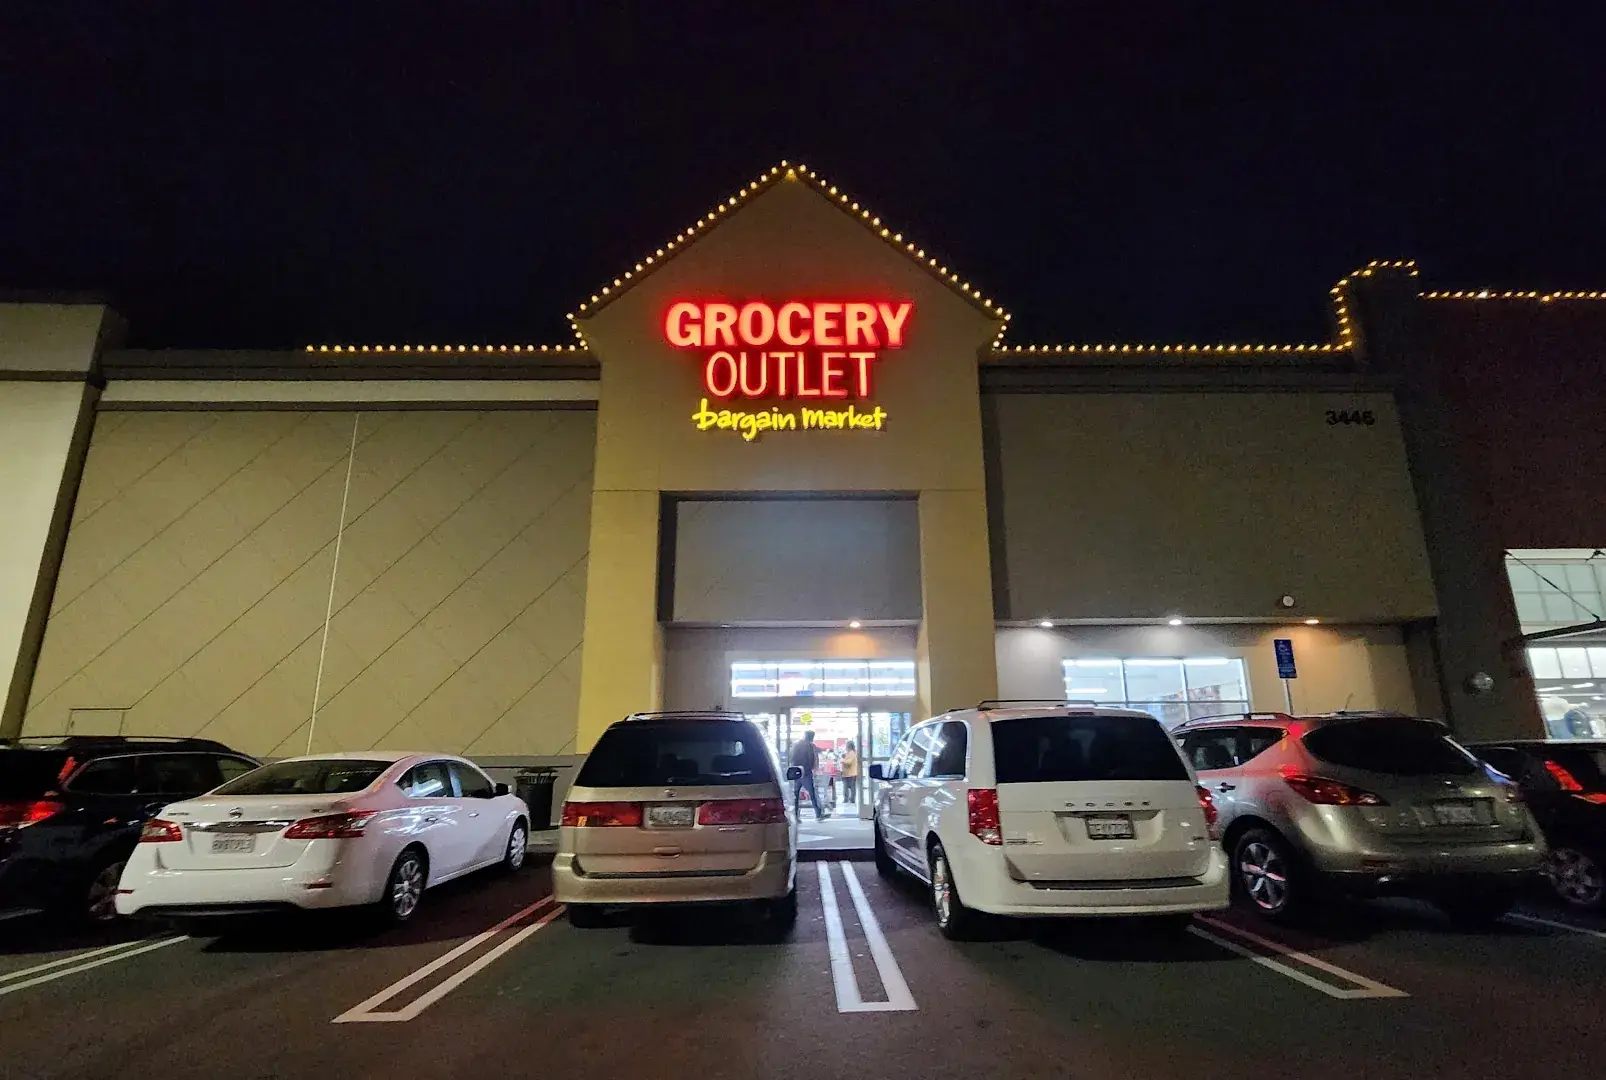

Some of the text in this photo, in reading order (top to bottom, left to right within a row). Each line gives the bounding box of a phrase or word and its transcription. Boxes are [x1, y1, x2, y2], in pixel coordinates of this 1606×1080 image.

[664, 301, 912, 348] GROCERY
[705, 350, 877, 398] OUTLET
[691, 397, 888, 441] bargain market
